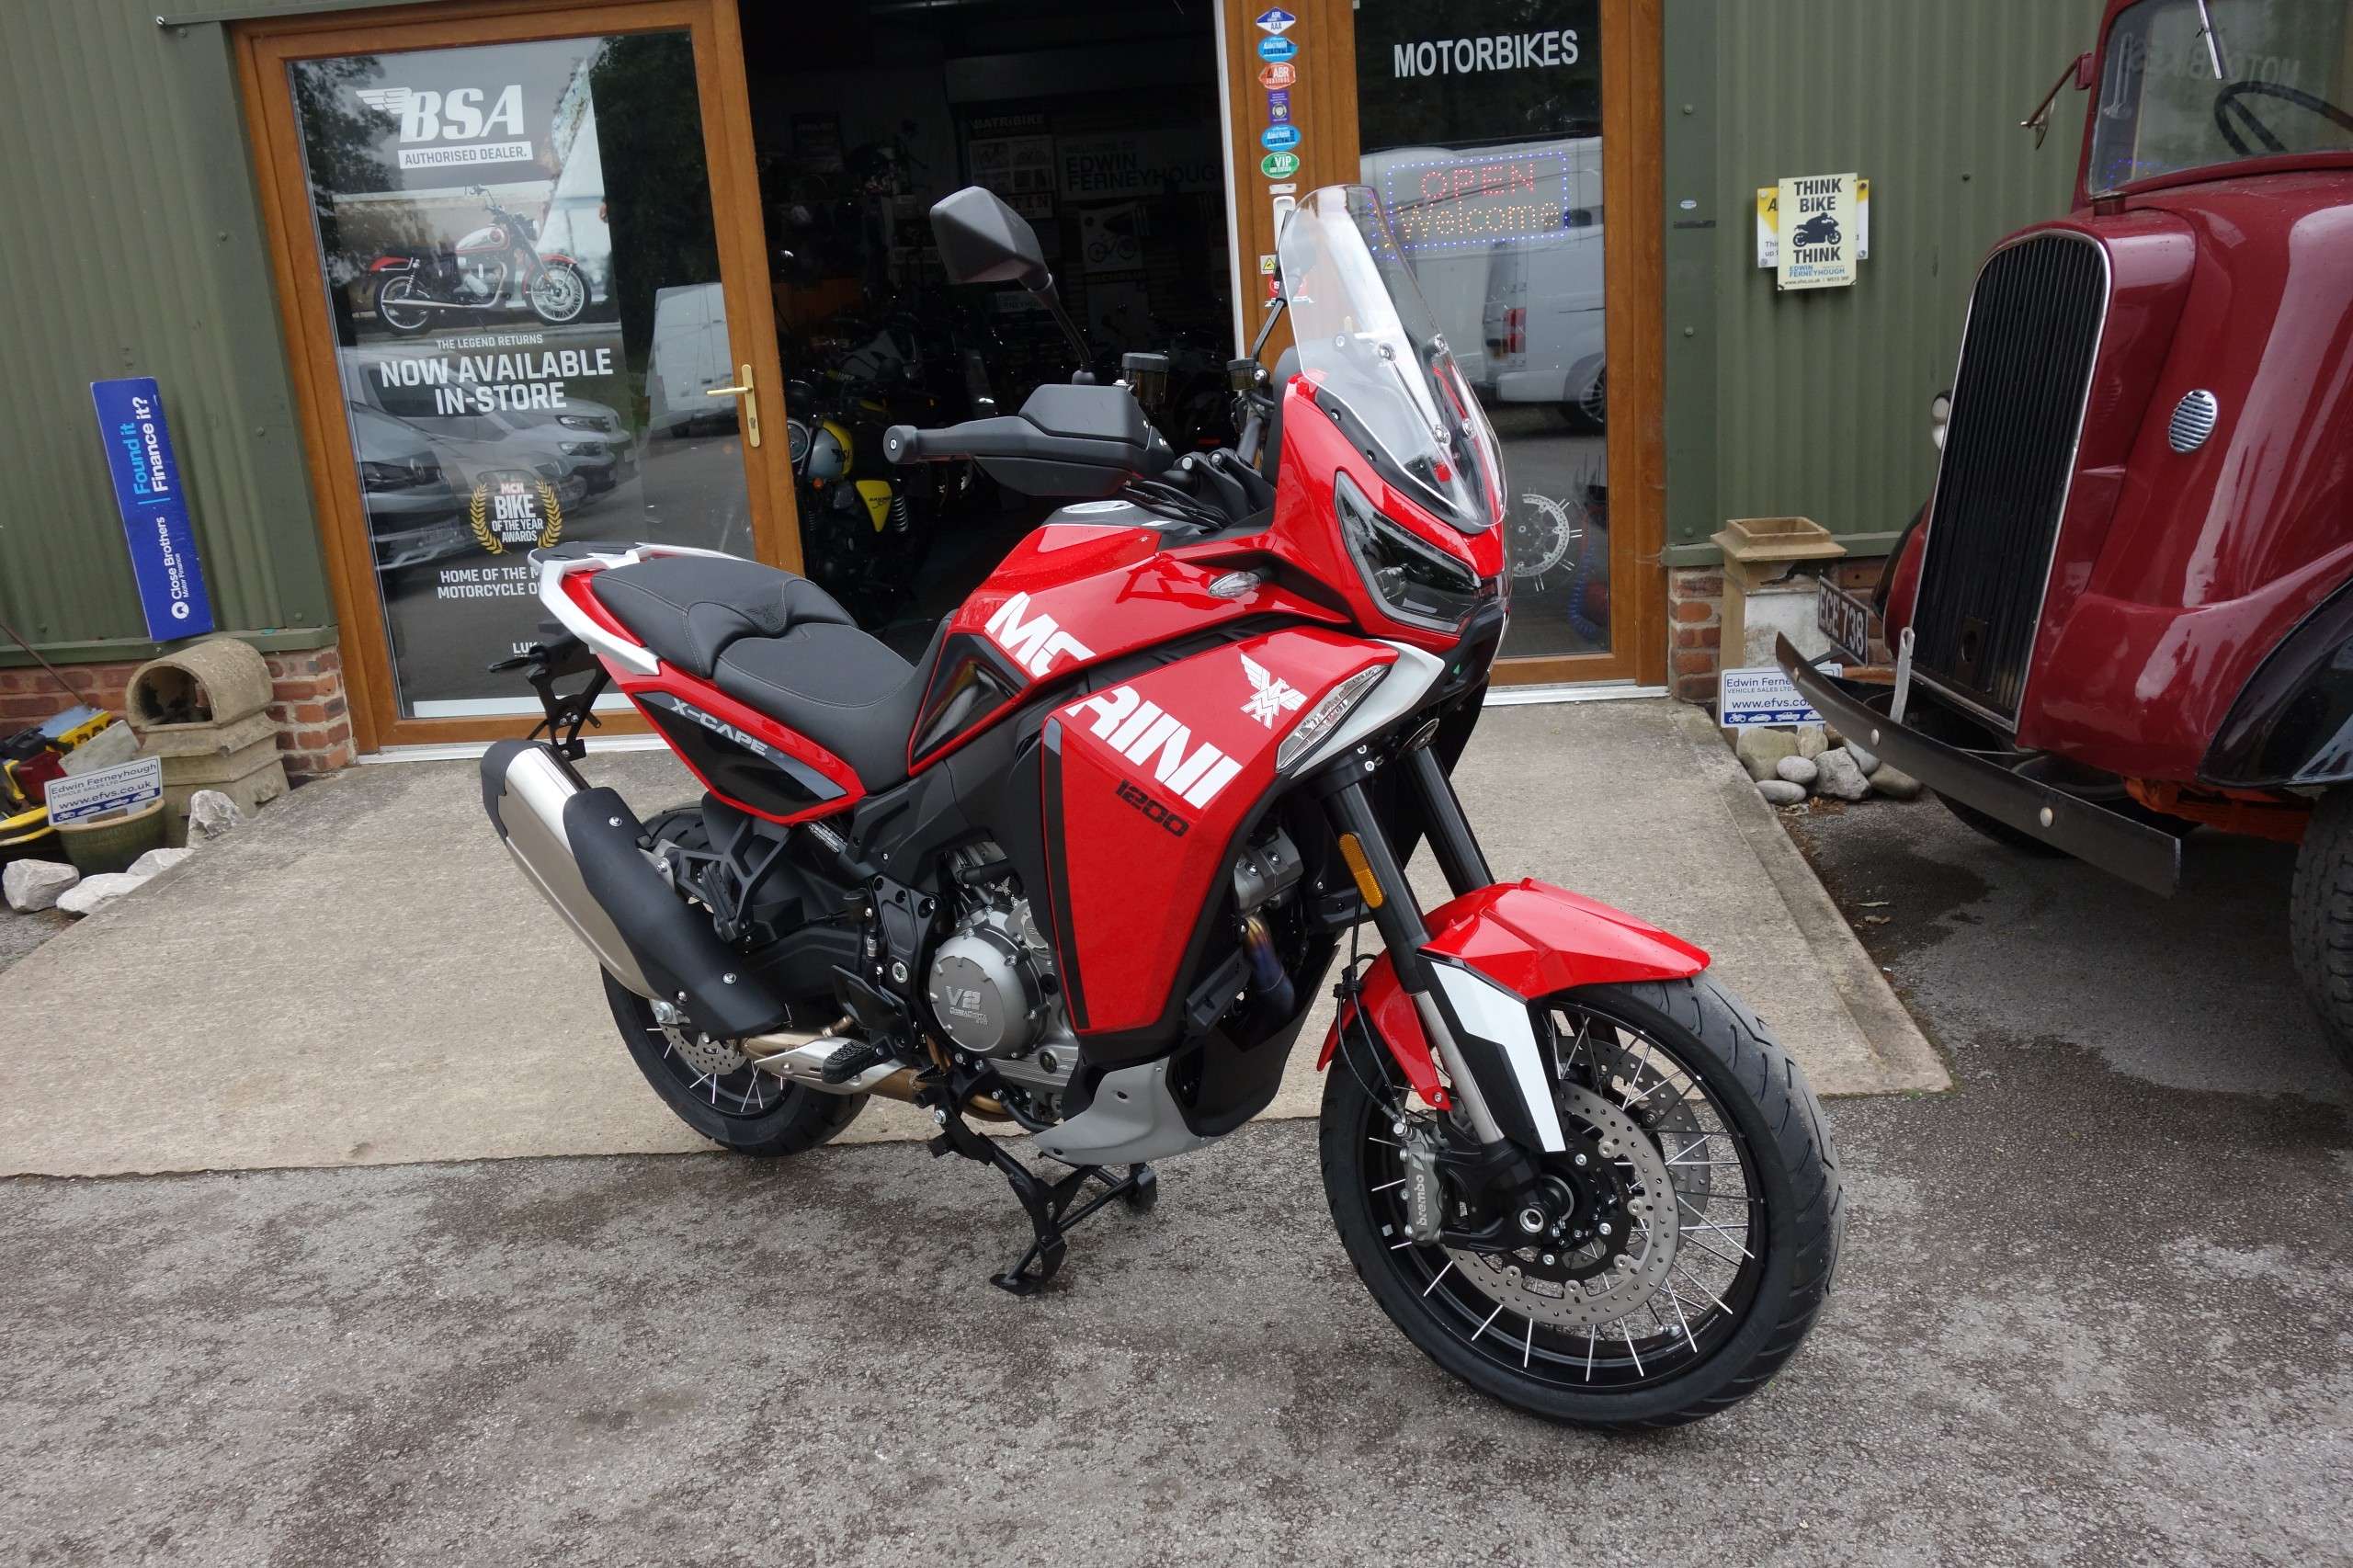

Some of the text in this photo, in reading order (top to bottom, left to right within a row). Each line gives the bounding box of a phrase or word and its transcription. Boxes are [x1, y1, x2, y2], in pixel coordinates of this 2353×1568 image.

[1393, 29, 1579, 78] MOTORBIKES
[1272, 66, 1290, 78] ABR
[399, 85, 524, 143] BSA
[404, 145, 528, 165] AUTHORISED DEALER.
[1066, 153, 1137, 175] EDWIN
[1274, 155, 1292, 166] VIP
[1420, 162, 1535, 200] OPEN
[1793, 177, 1843, 197] THINK
[1800, 196, 1836, 213] BIKE
[1397, 200, 1560, 239] Welcome
[1793, 246, 1841, 264] THINK
[436, 334, 544, 350] THE LEGEND RETURNS
[380, 347, 614, 388] NOW AVAILABLE
[435, 381, 567, 415] IN-STORE
[131, 396, 169, 493] Finance it?
[119, 422, 151, 495] Found it
[500, 483, 525, 494] MCN
[494, 494, 537, 519] BIKE
[491, 517, 544, 532] OF THE YEAR
[502, 530, 538, 543] AWARDS
[156, 516, 183, 600] Close Brothers
[440, 569, 479, 583] HOME
[482, 568, 499, 581] OF
[501, 566, 527, 580] THE
[437, 582, 526, 599] MOTORCYCLE
[1819, 585, 1865, 656] ECE 738
[1726, 677, 1758, 687] Edwin
[671, 698, 768, 756] X-CAPE
[51, 763, 157, 796] Edwin Ferneyhough
[58, 779, 152, 810] www.efvs.co.uk
[1115, 779, 1190, 837] 1200
[945, 985, 981, 1011] V2
[1414, 1174, 1427, 1226] brembo
